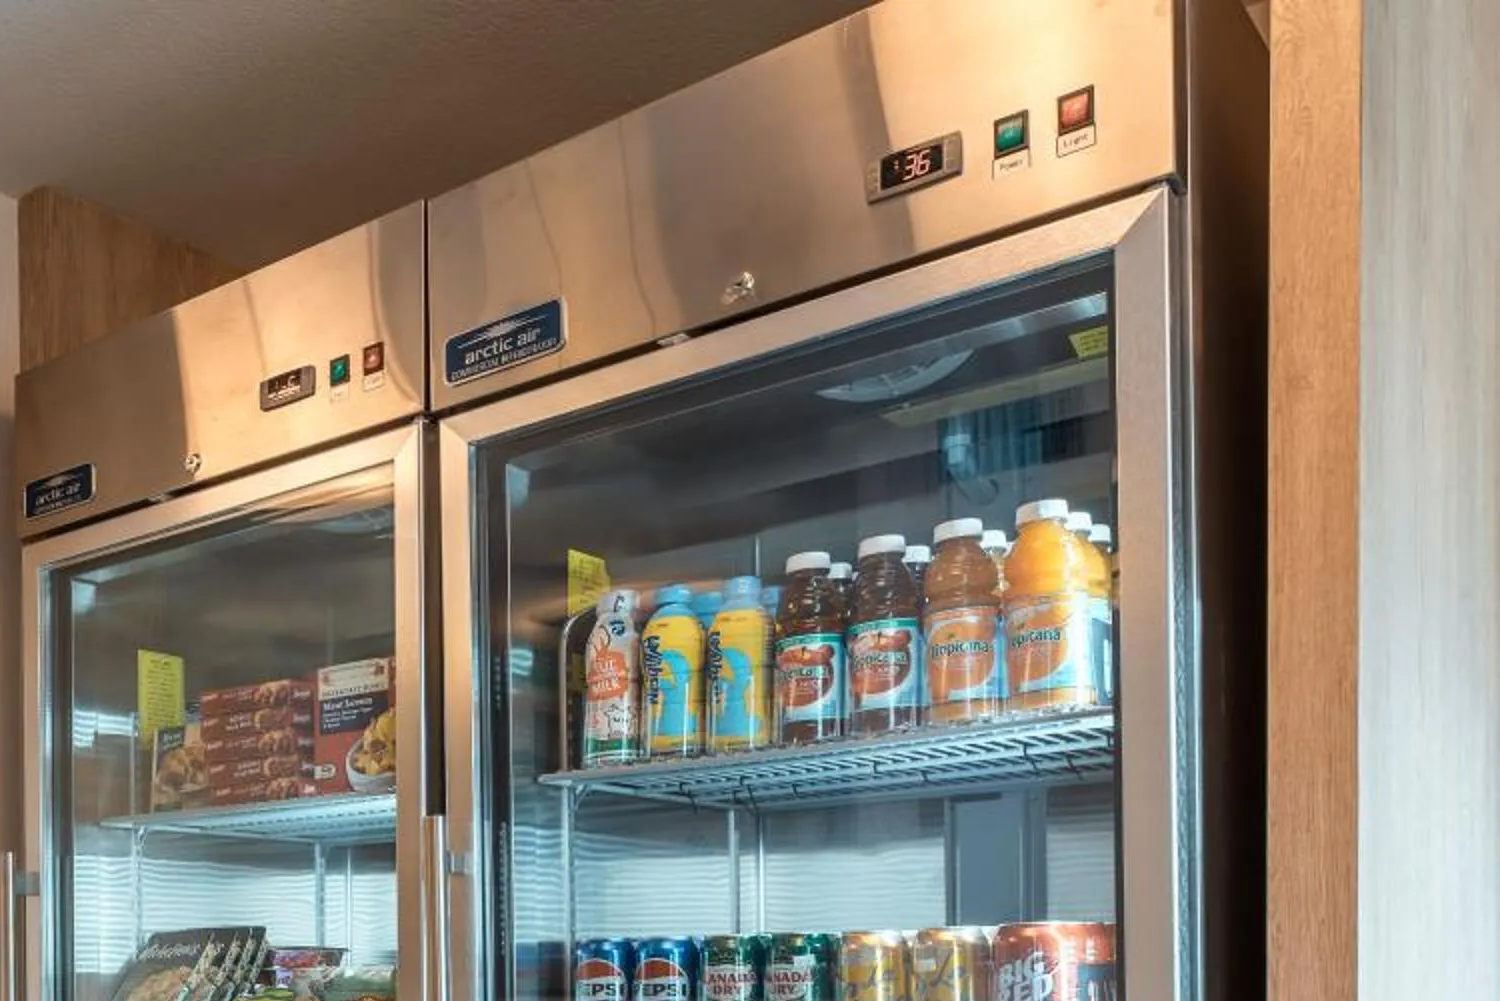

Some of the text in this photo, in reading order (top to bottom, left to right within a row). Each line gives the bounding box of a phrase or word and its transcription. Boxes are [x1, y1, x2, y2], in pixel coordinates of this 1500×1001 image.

[902, 150, 931, 181] 36
[465, 326, 541, 365] arctic air
[999, 951, 1047, 988] BIG
